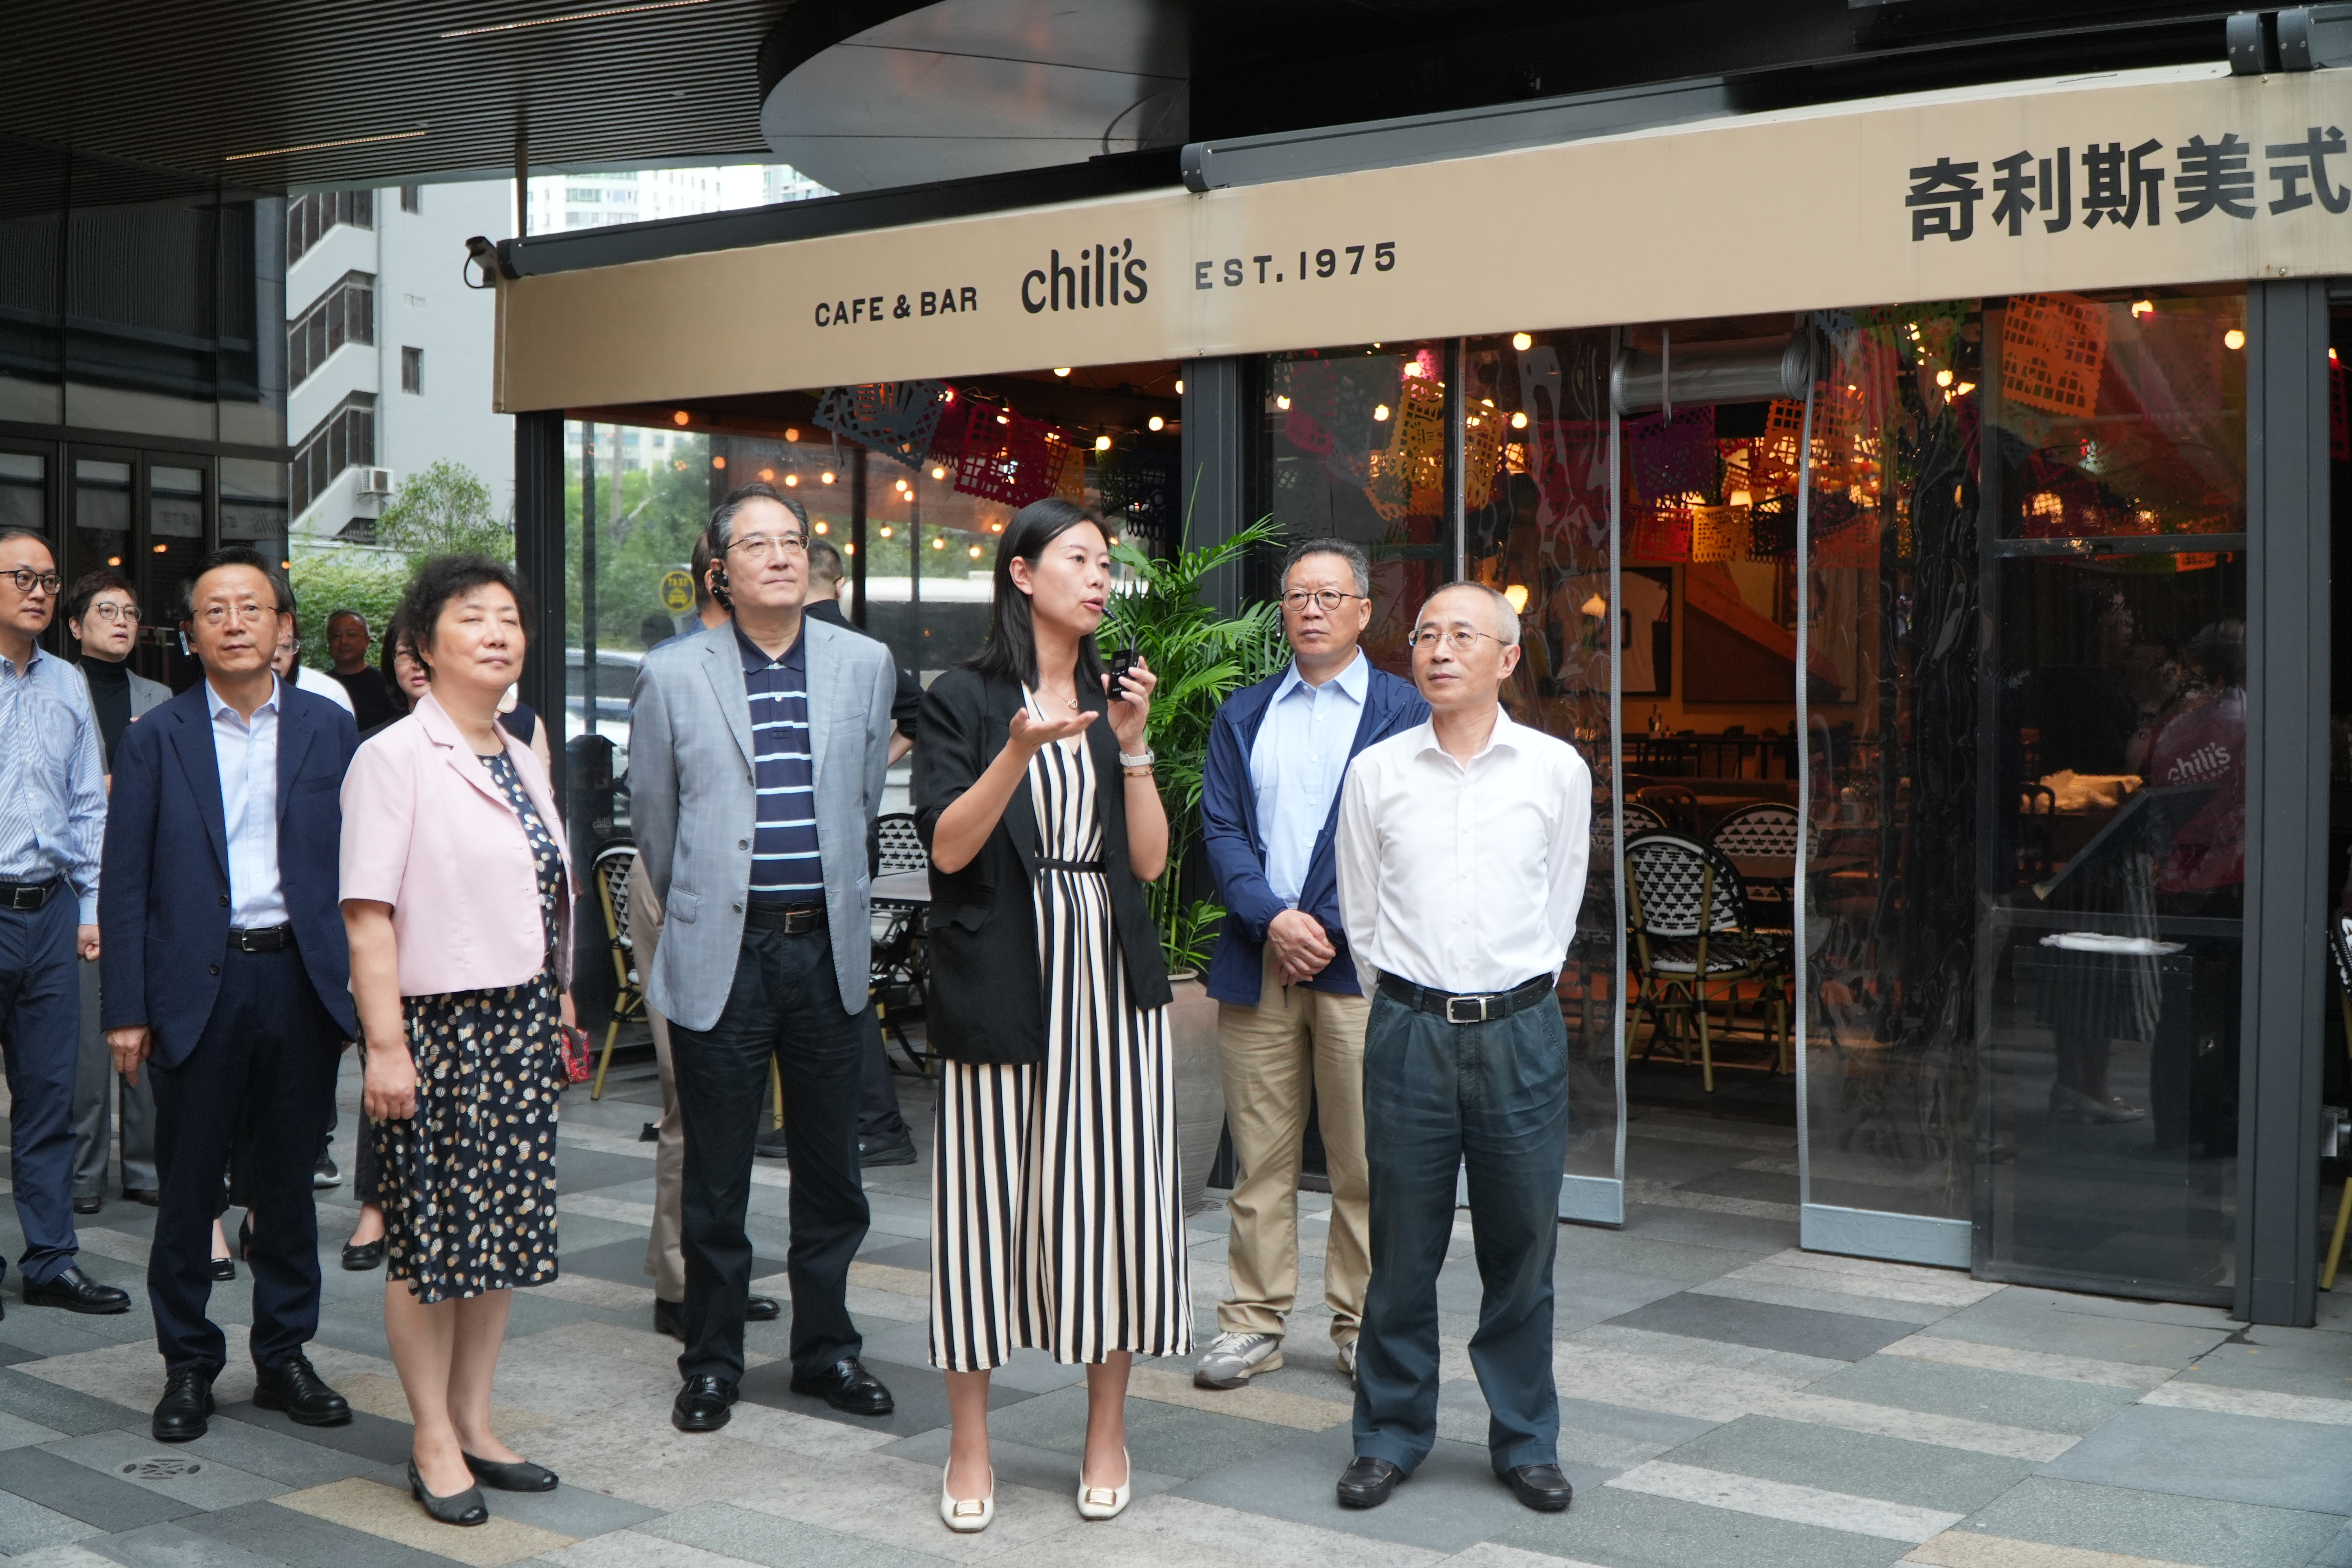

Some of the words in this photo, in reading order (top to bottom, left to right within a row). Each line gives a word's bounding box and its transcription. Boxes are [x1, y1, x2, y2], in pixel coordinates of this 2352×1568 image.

[1905, 125, 2351, 242] 奇利斯美式
[815, 296, 884, 327] CAFE
[893, 294, 911, 319] &
[920, 287, 977, 316] BAR
[1021, 238, 1148, 314] chili's
[1196, 255, 1283, 290] EST.
[1300, 242, 1395, 280] 1975
